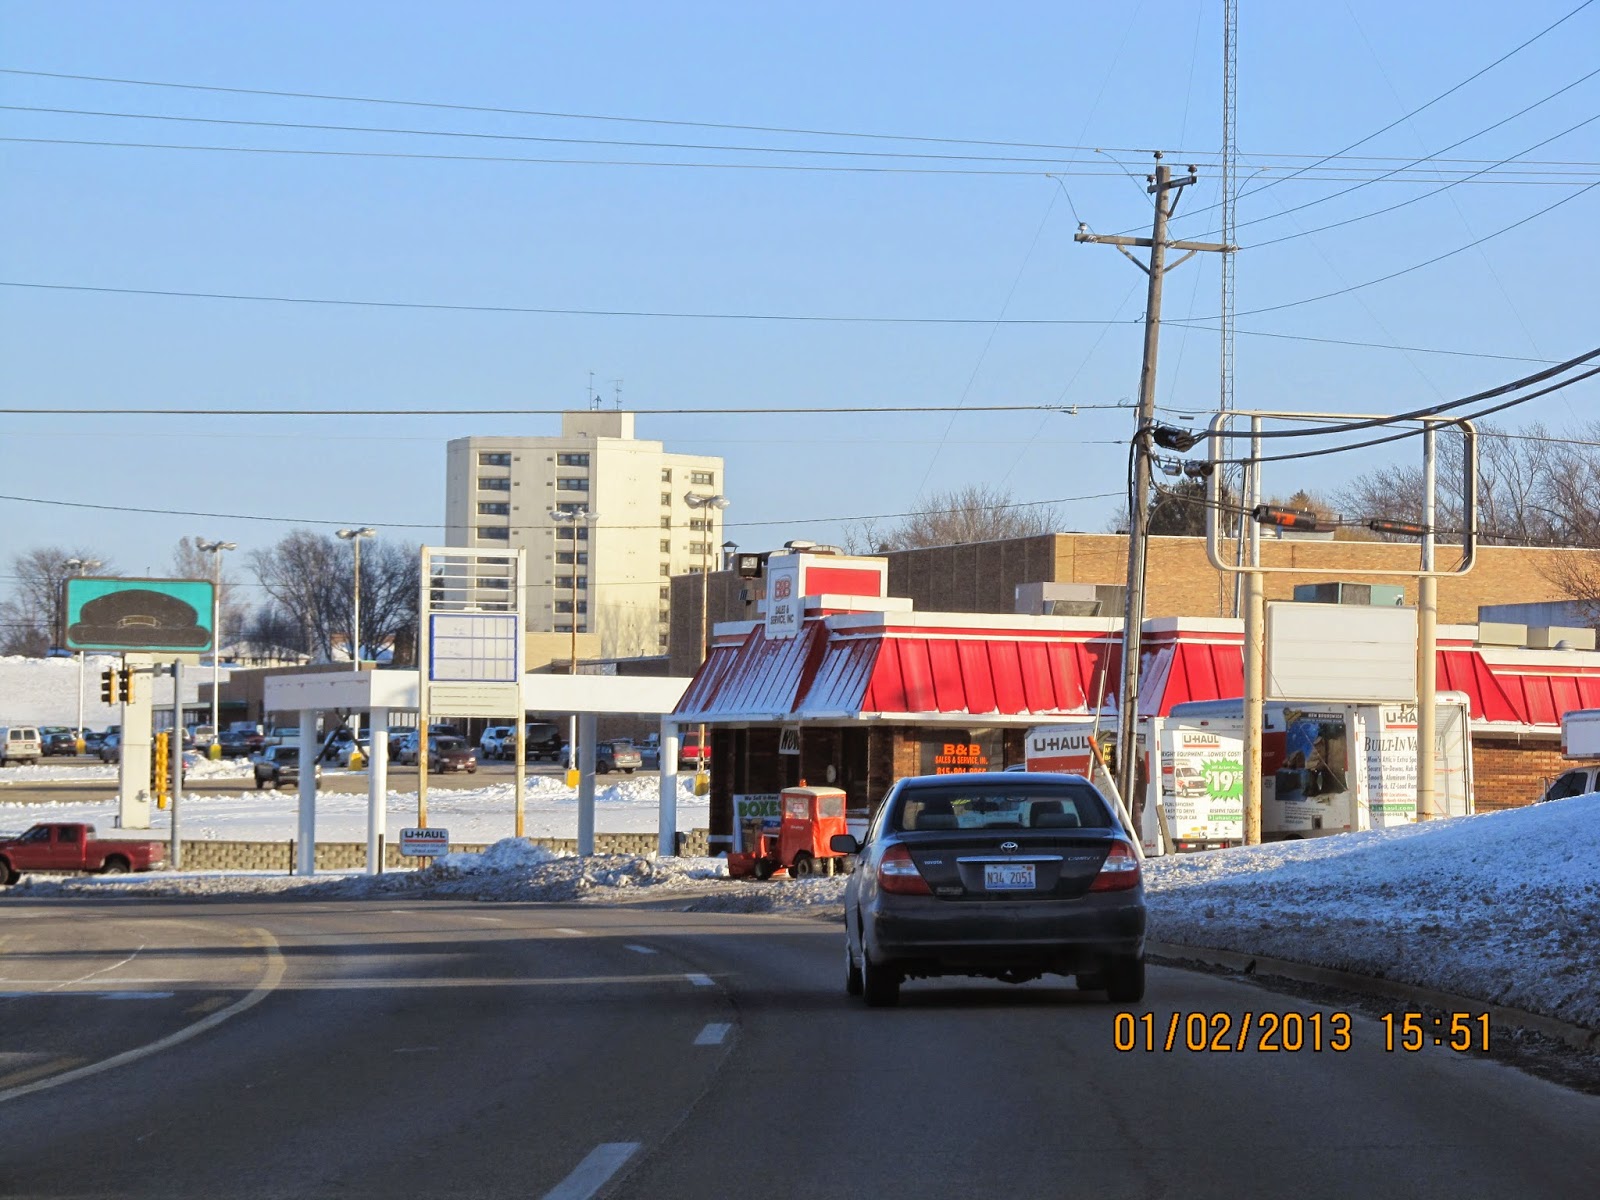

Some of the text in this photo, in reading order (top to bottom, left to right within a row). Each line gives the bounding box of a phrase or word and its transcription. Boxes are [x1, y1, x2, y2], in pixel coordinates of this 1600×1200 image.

[1386, 712, 1418, 723] U-HA
[1033, 736, 1090, 752] U-HAUL
[1184, 735, 1219, 744] U-HAUL
[405, 830, 446, 839] U-HAUL
[1010, 871, 1034, 885] 2051
